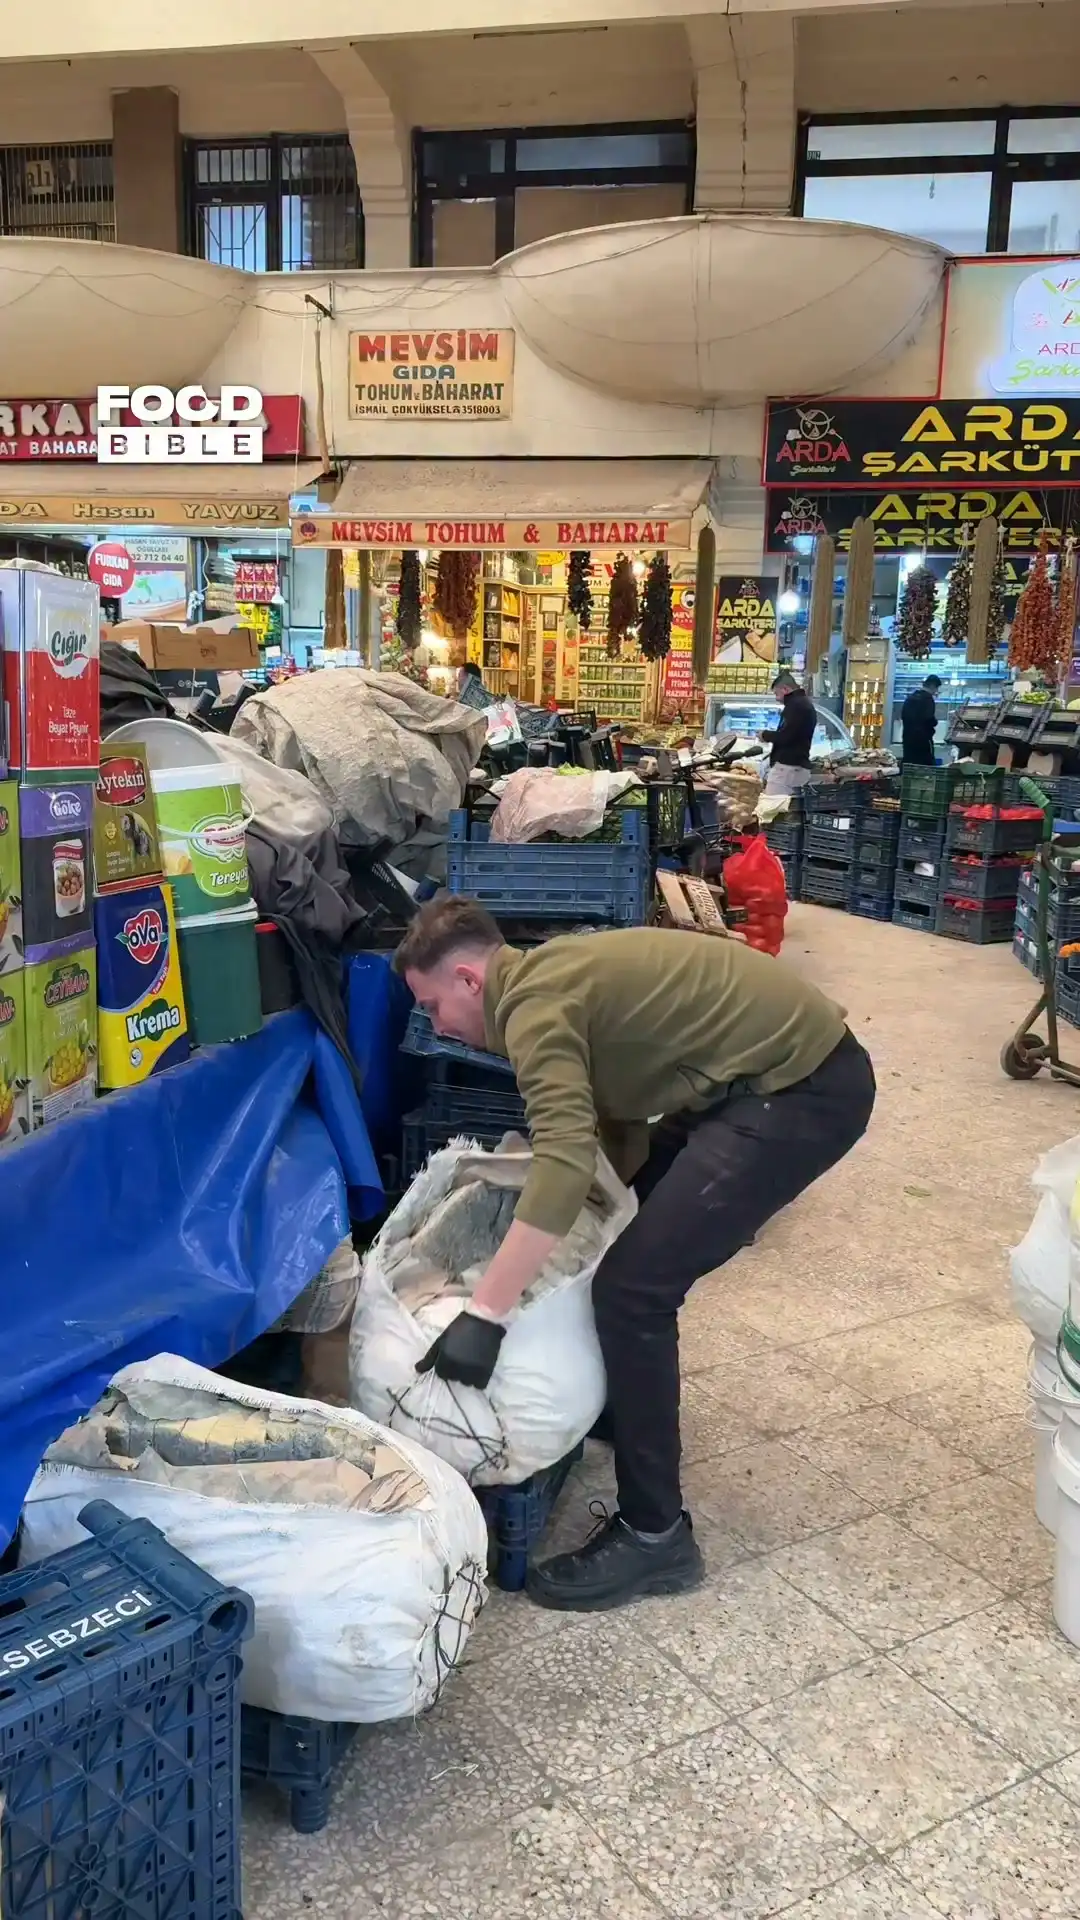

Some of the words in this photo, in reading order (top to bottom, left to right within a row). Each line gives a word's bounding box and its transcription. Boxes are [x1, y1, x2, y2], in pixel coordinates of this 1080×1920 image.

[359, 329, 498, 362] MEVSİM
[393, 365, 455, 380] GIDA
[355, 384, 413, 401] TOHUM
[423, 383, 504, 401] BAHARAT
[462, 405, 501, 414] 3518003
[901, 405, 1080, 442] ARD
[29, 440, 98, 455] BAHARA
[776, 441, 851, 462] ARDA
[72, 503, 155, 519] Hasan
[182, 503, 280, 520] YAVUZ
[869, 491, 1043, 521] ARDA
[425, 522, 506, 543] TOHUM
[523, 523, 541, 543] &
[557, 522, 669, 543] BAHARAT
[775, 519, 828, 535] ARDA
[103, 573, 123, 588] GIDA
[718, 598, 776, 617] ARDA
[126, 1007, 181, 1041] Krema
